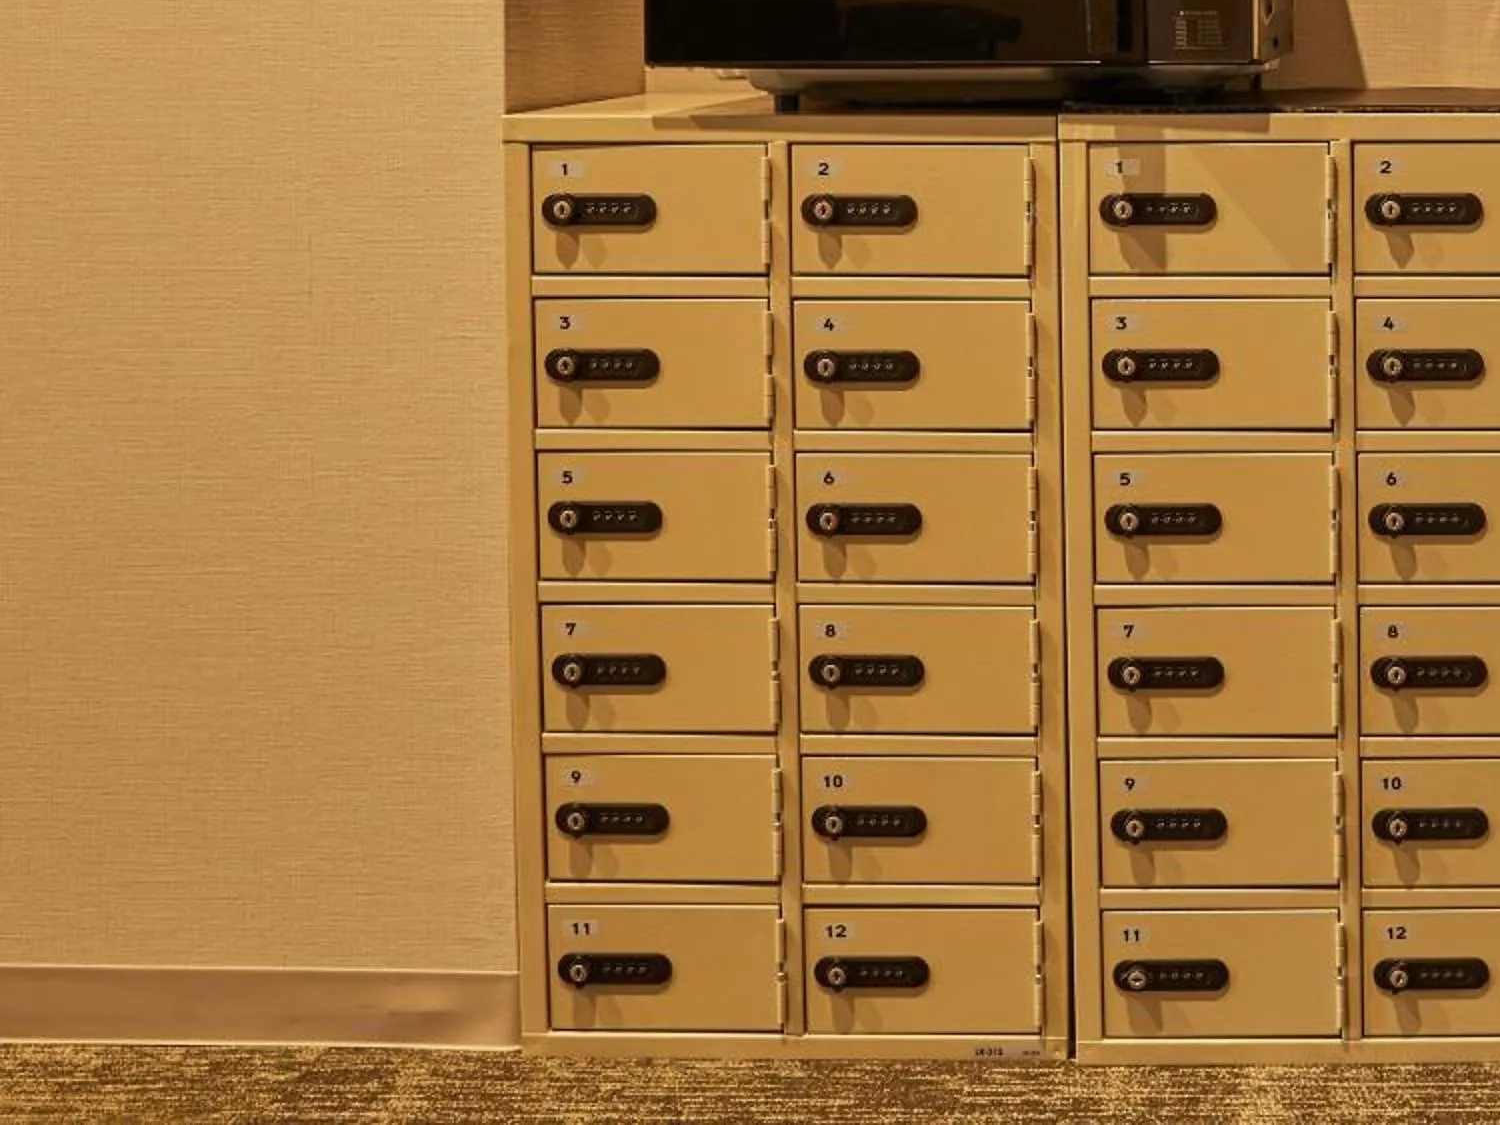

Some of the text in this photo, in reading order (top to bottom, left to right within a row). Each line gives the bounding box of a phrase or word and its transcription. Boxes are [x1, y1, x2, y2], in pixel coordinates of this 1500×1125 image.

[817, 162, 829, 176] 2
[1379, 160, 1392, 175] 2
[559, 316, 571, 330] 3
[823, 318, 835, 332] 4
[1115, 316, 1127, 331] 3
[1383, 316, 1395, 331] 4
[561, 470, 573, 485] 5
[823, 470, 835, 486] 6
[1119, 472, 1131, 487] 5
[1385, 472, 1397, 487] 6
[565, 622, 577, 636] 7
[825, 624, 837, 638] 8
[1123, 624, 1135, 639] 7
[1387, 624, 1399, 639] 8
[570, 770, 582, 784] 9
[823, 774, 843, 788] 10
[1124, 777, 1136, 791] 9
[1382, 776, 1402, 791] 10
[572, 922, 590, 936] 11
[826, 924, 847, 938] 12
[1123, 929, 1140, 943] 11
[1387, 926, 1407, 940] 12
